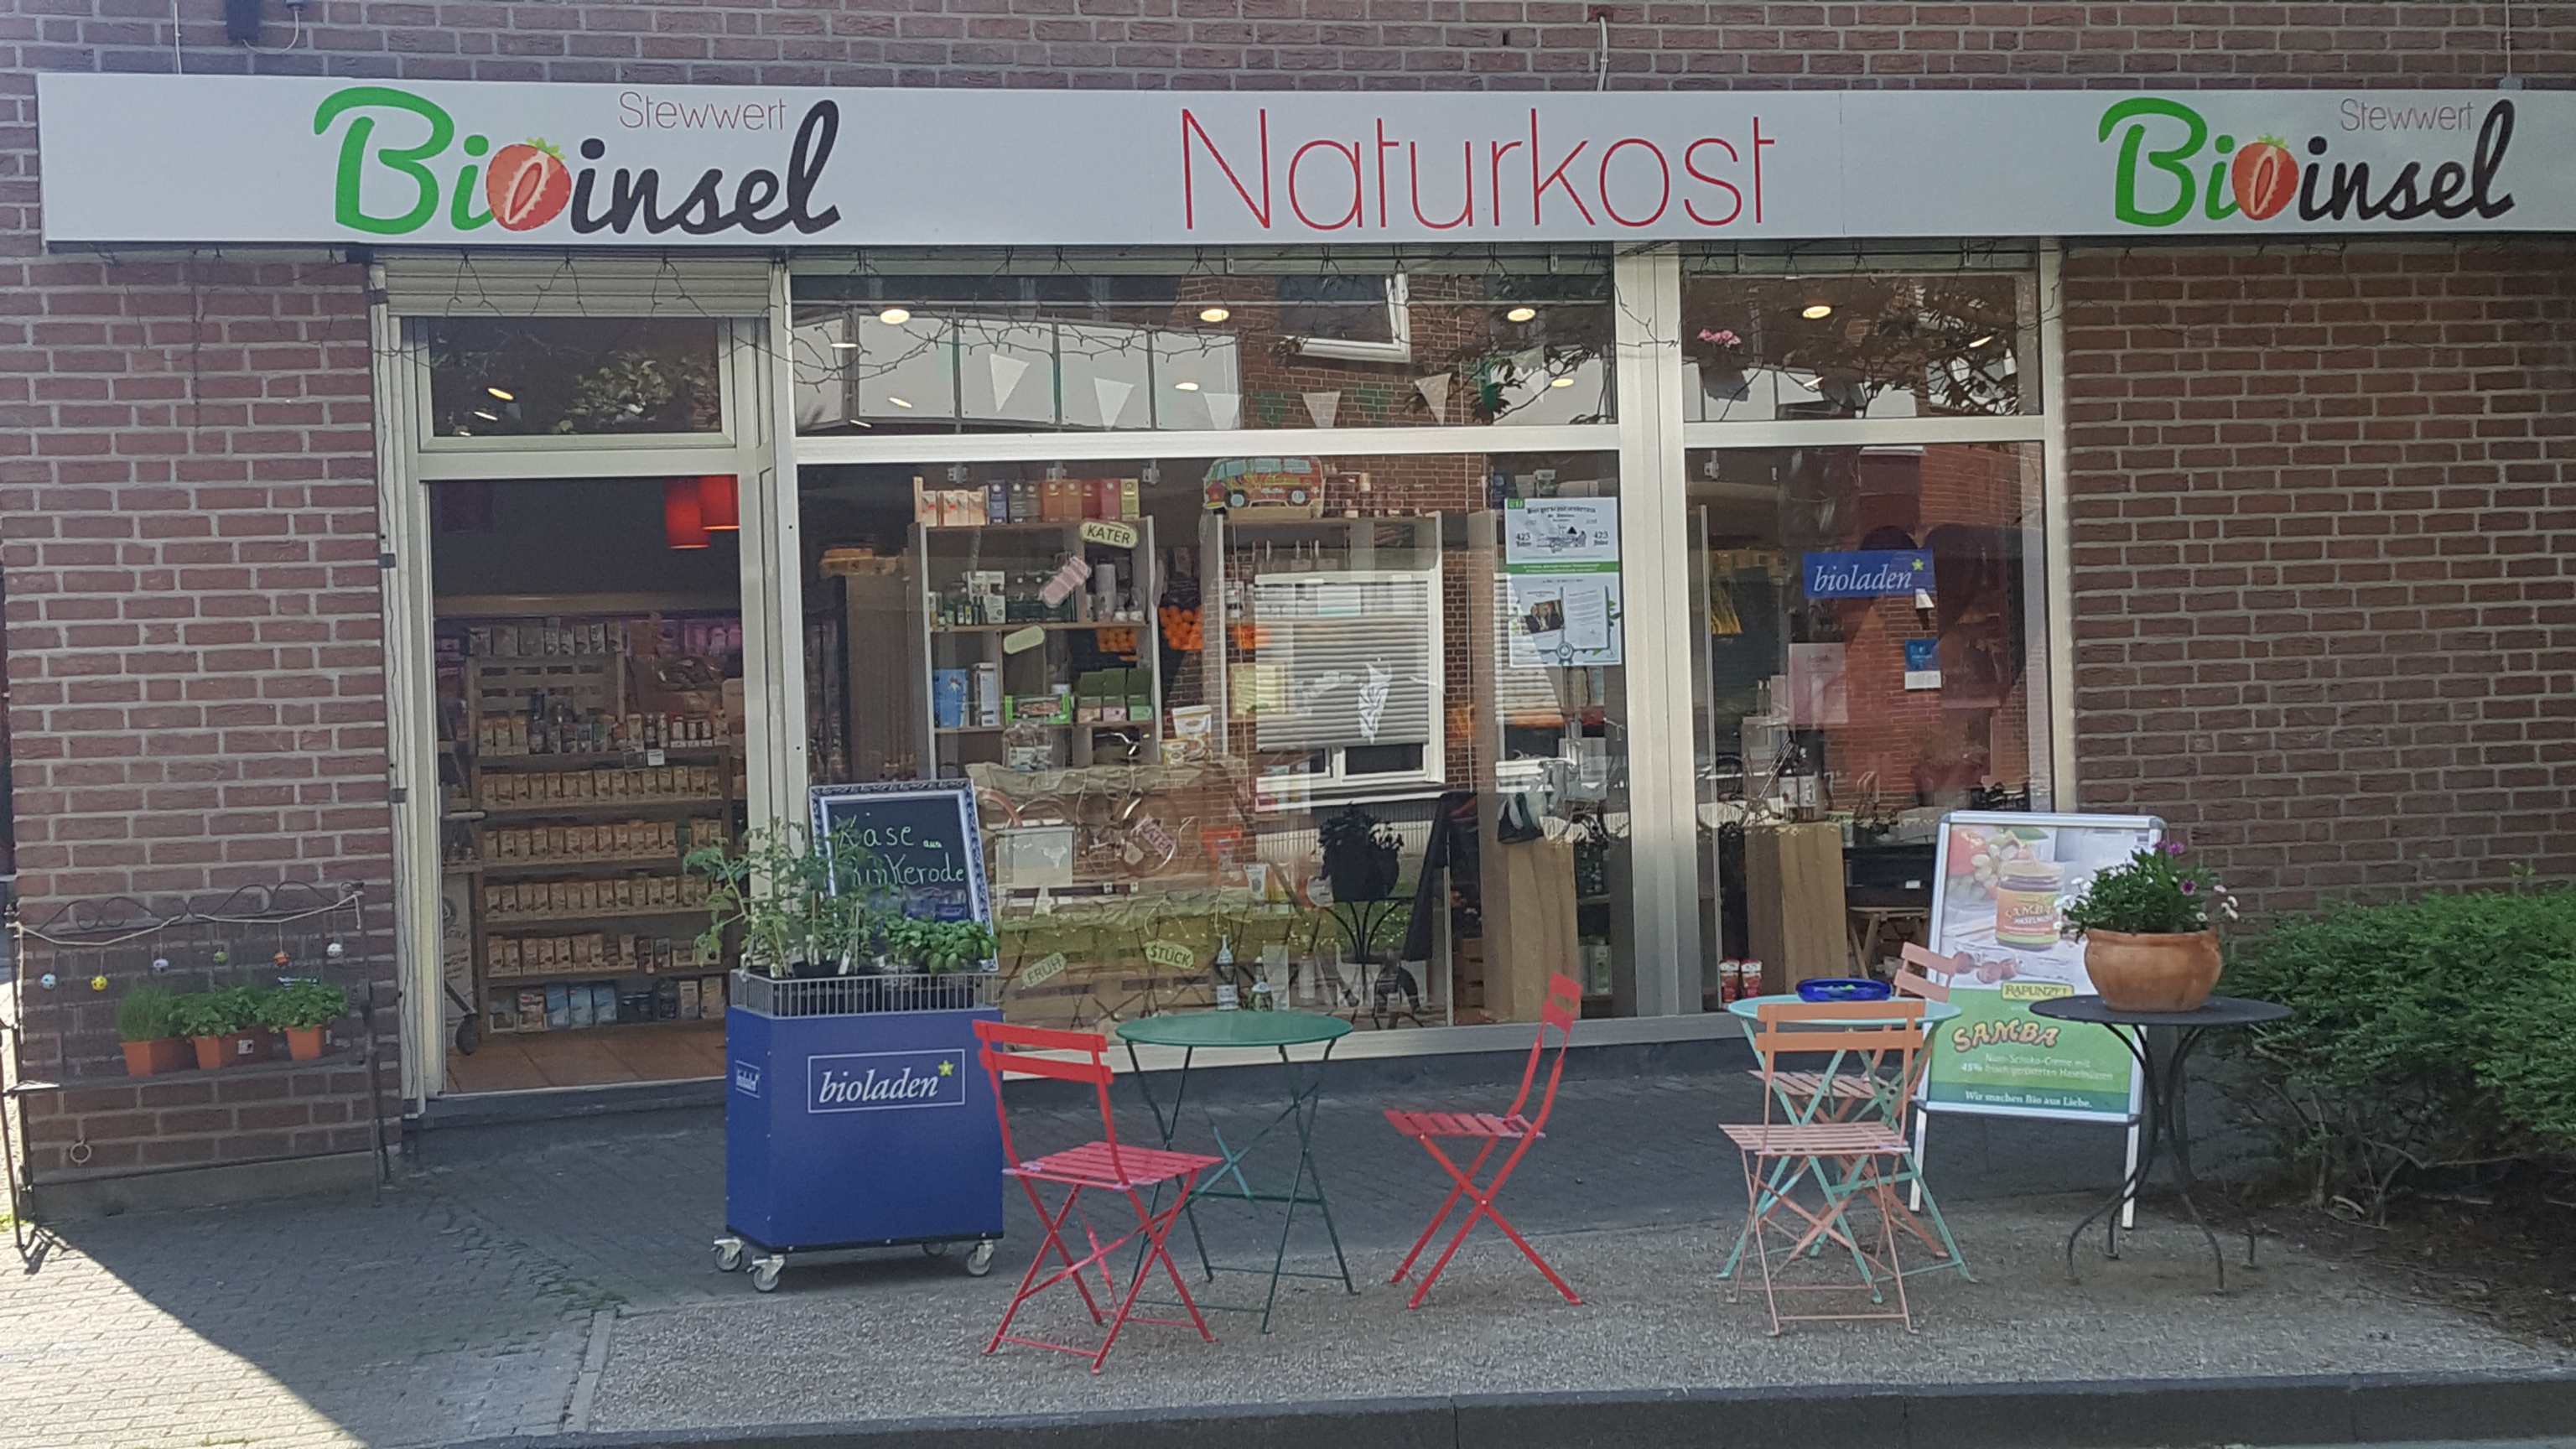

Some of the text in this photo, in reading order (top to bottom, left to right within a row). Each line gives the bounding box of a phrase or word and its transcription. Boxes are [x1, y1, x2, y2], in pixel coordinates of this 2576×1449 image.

[619, 90, 787, 132] Stewwert
[2340, 97, 2475, 132] Stewwert
[1182, 107, 1777, 231] Naturkost
[1087, 523, 1131, 545] KATER
[1813, 564, 1913, 592] bioladen
[923, 839, 943, 848] aus
[1951, 1018, 2061, 1053] SAMBA
[1961, 1062, 1983, 1072] 45%
[818, 1067, 939, 1104] bioladen
[1965, 1090, 2093, 1109] Wir machen Bio aus Liebe.
